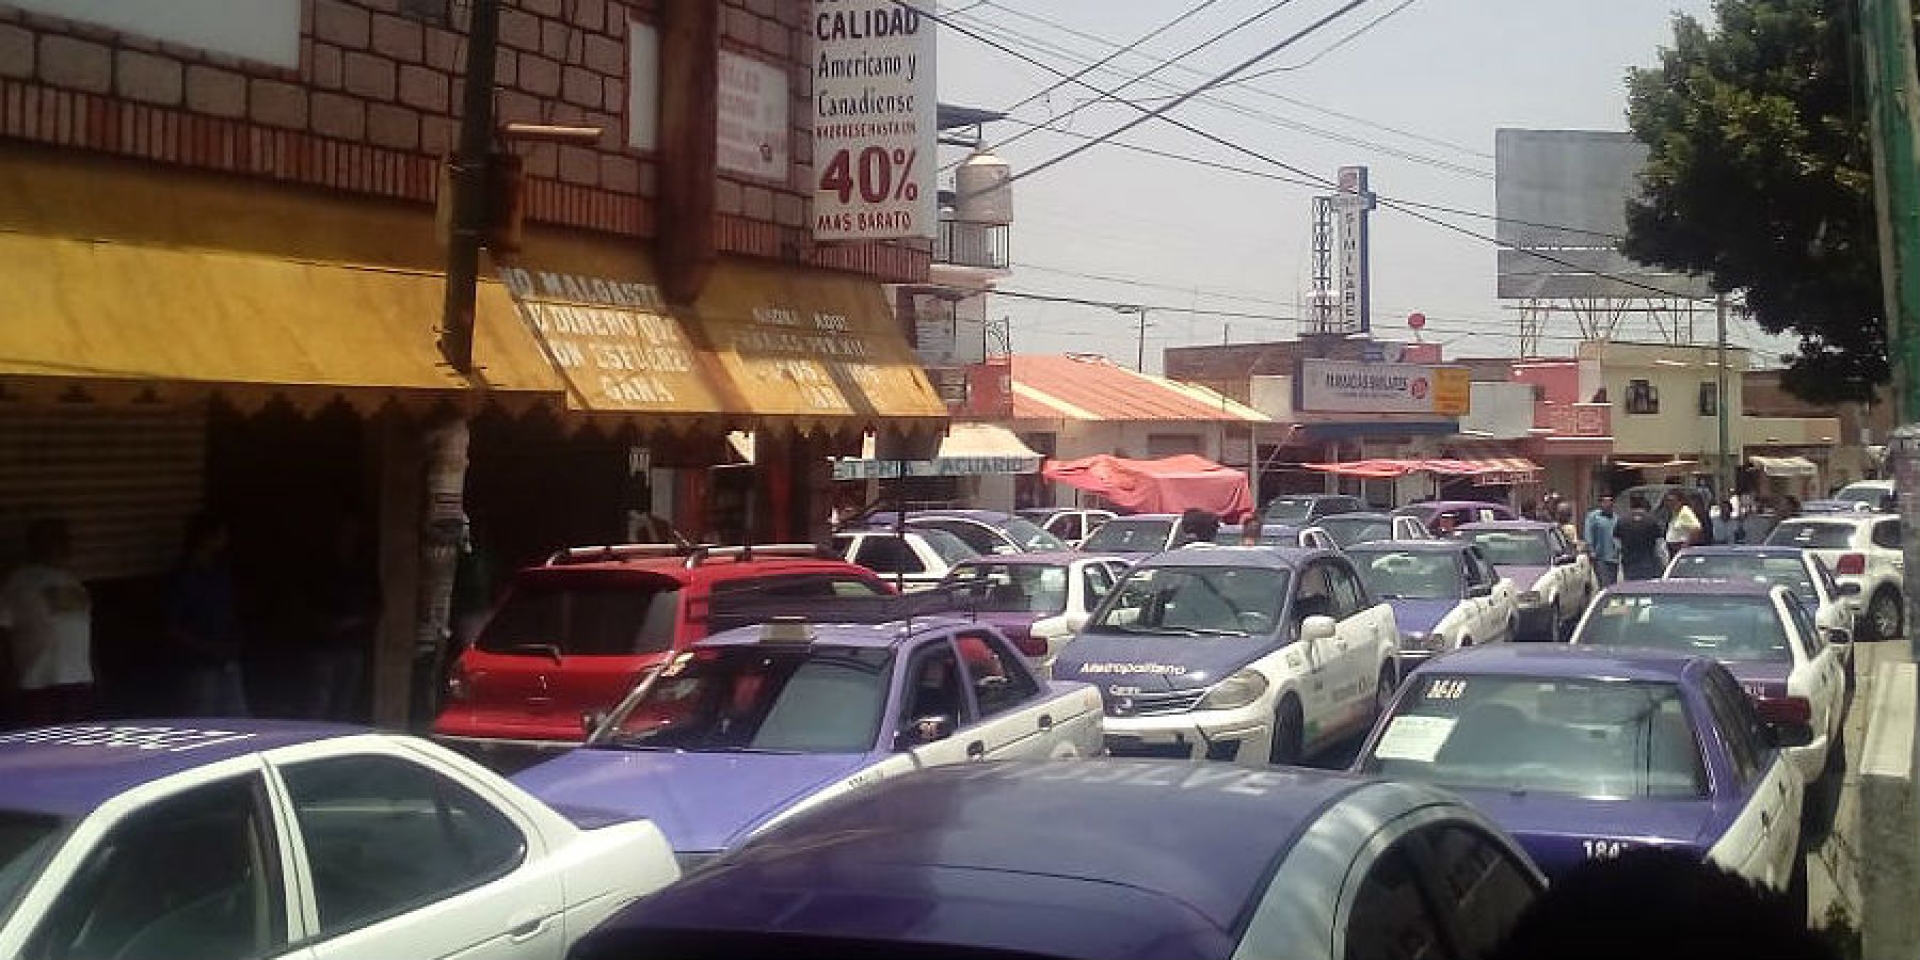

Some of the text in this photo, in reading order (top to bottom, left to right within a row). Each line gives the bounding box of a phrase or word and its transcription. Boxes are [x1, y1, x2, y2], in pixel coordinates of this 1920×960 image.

[816, 8, 919, 41] CALIDAD
[818, 51, 917, 82] Americano y
[818, 88, 914, 117] Canadiense
[819, 146, 918, 203] 40%
[817, 211, 912, 231] MAS BARATO
[538, 272, 661, 308] MALGAST
[1582, 840, 1629, 859] 184
